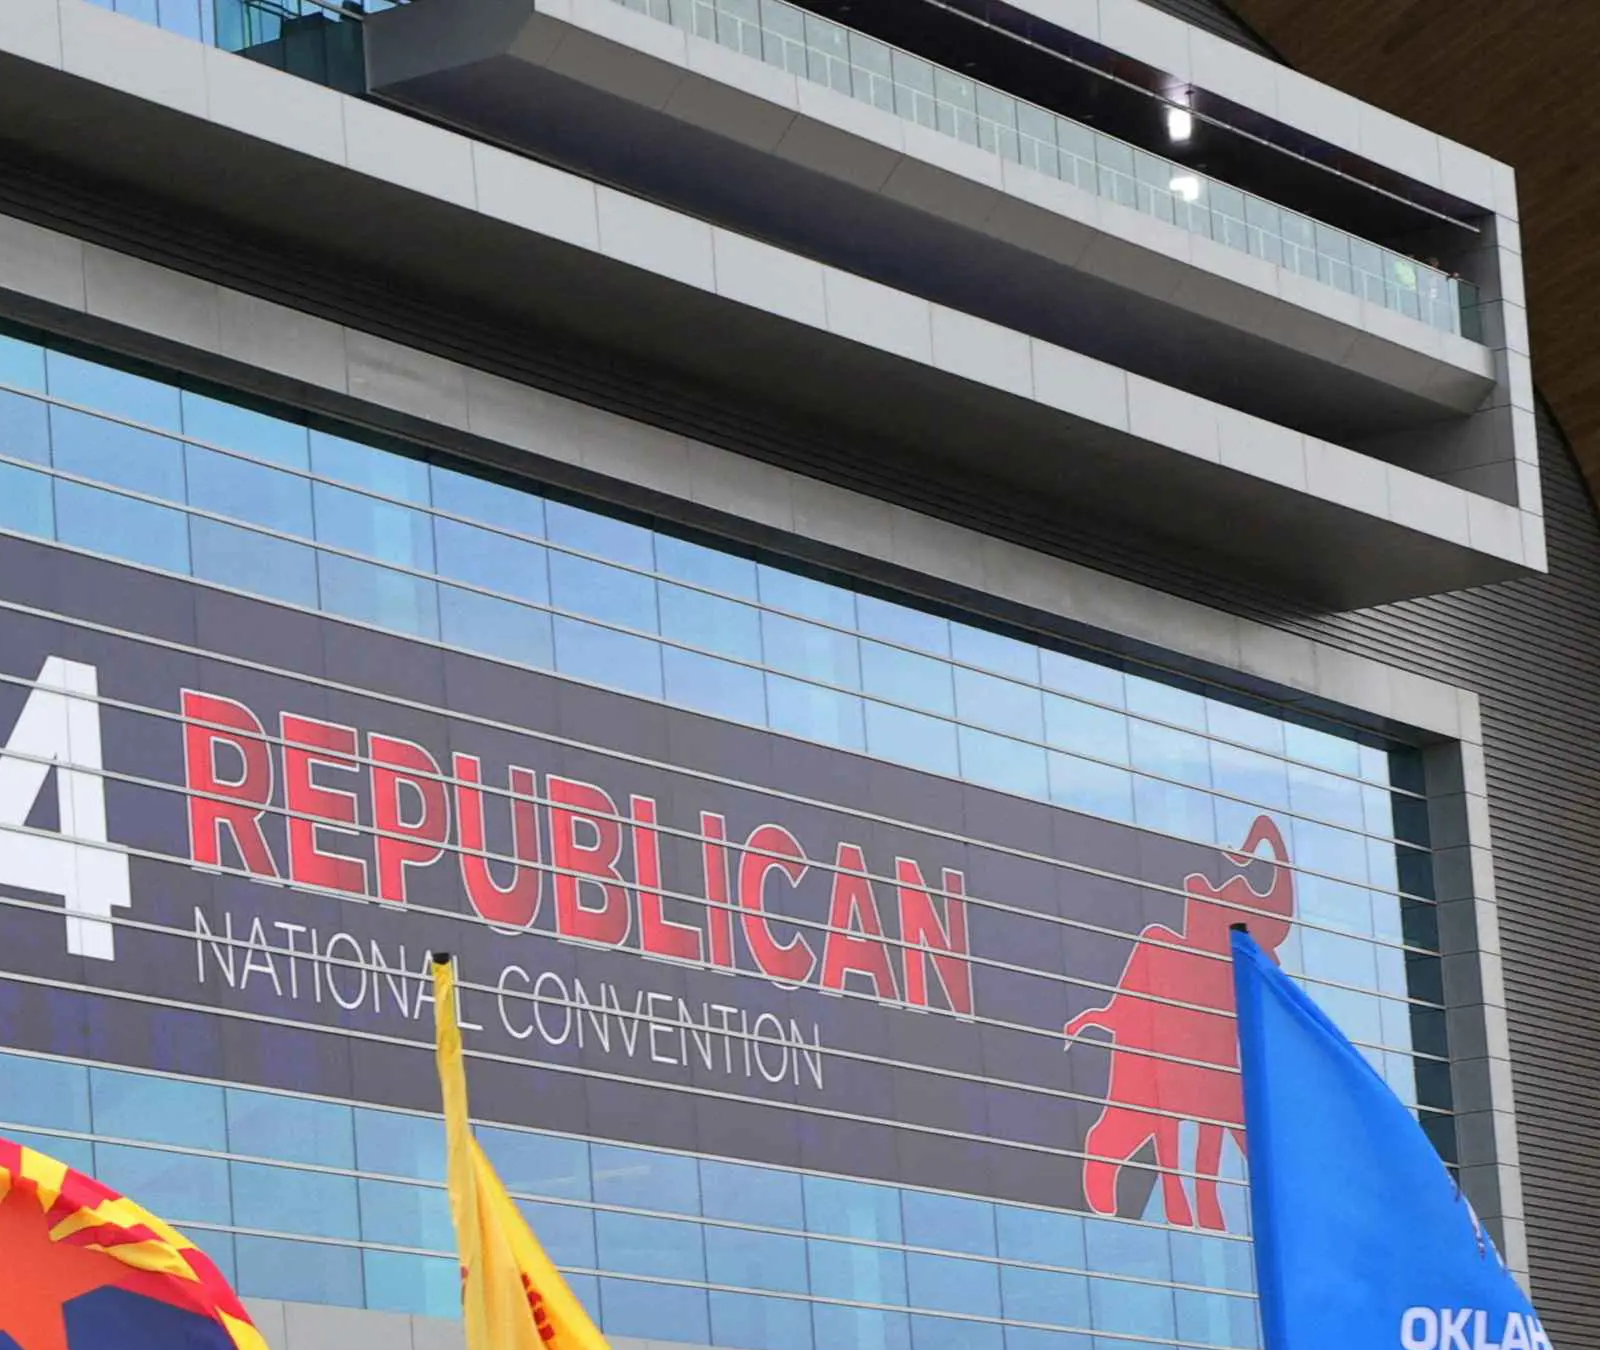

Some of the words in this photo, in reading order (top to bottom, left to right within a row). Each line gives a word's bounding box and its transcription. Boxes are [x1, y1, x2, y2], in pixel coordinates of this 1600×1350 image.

[180, 688, 975, 1022] REPUBLICAN
[194, 906, 482, 1031] NATIONAL
[499, 964, 824, 1090] CONVENTION
